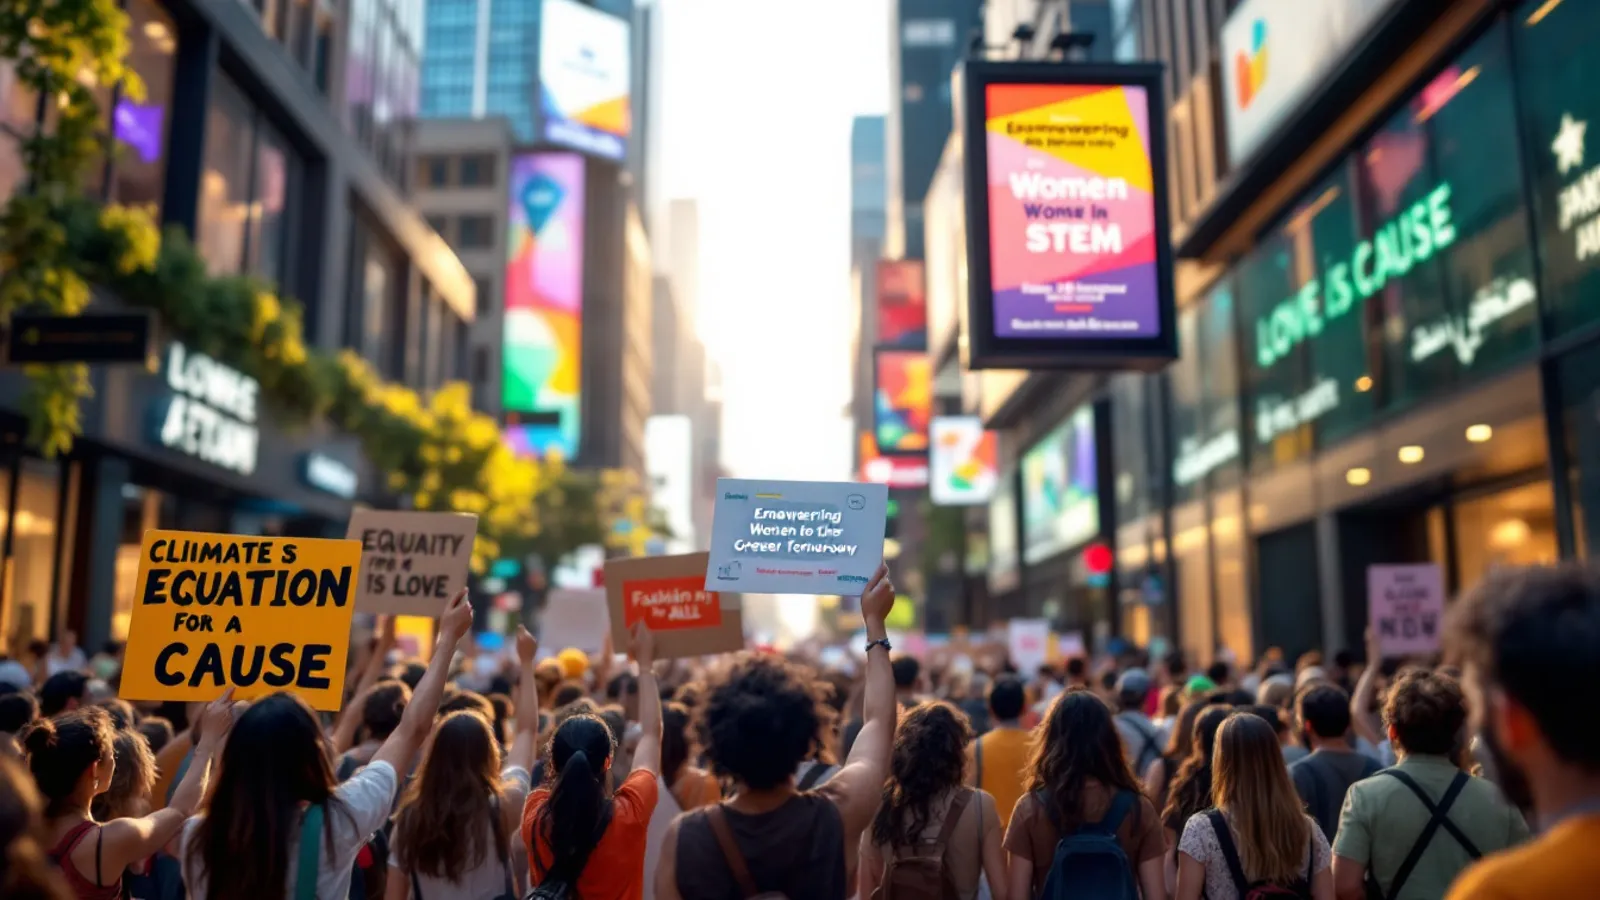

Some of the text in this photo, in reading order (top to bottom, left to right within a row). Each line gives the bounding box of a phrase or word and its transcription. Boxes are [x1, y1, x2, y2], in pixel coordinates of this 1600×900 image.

[1009, 172, 1128, 200] Women
[1025, 223, 1122, 253] STEM
[1256, 280, 1324, 367] LOVE
[1352, 182, 1456, 297] CAUSE
[281, 544, 297, 564] S
[393, 574, 449, 598] LOVE
[173, 613, 242, 633] FOR A
[154, 642, 332, 689] CAUSE
